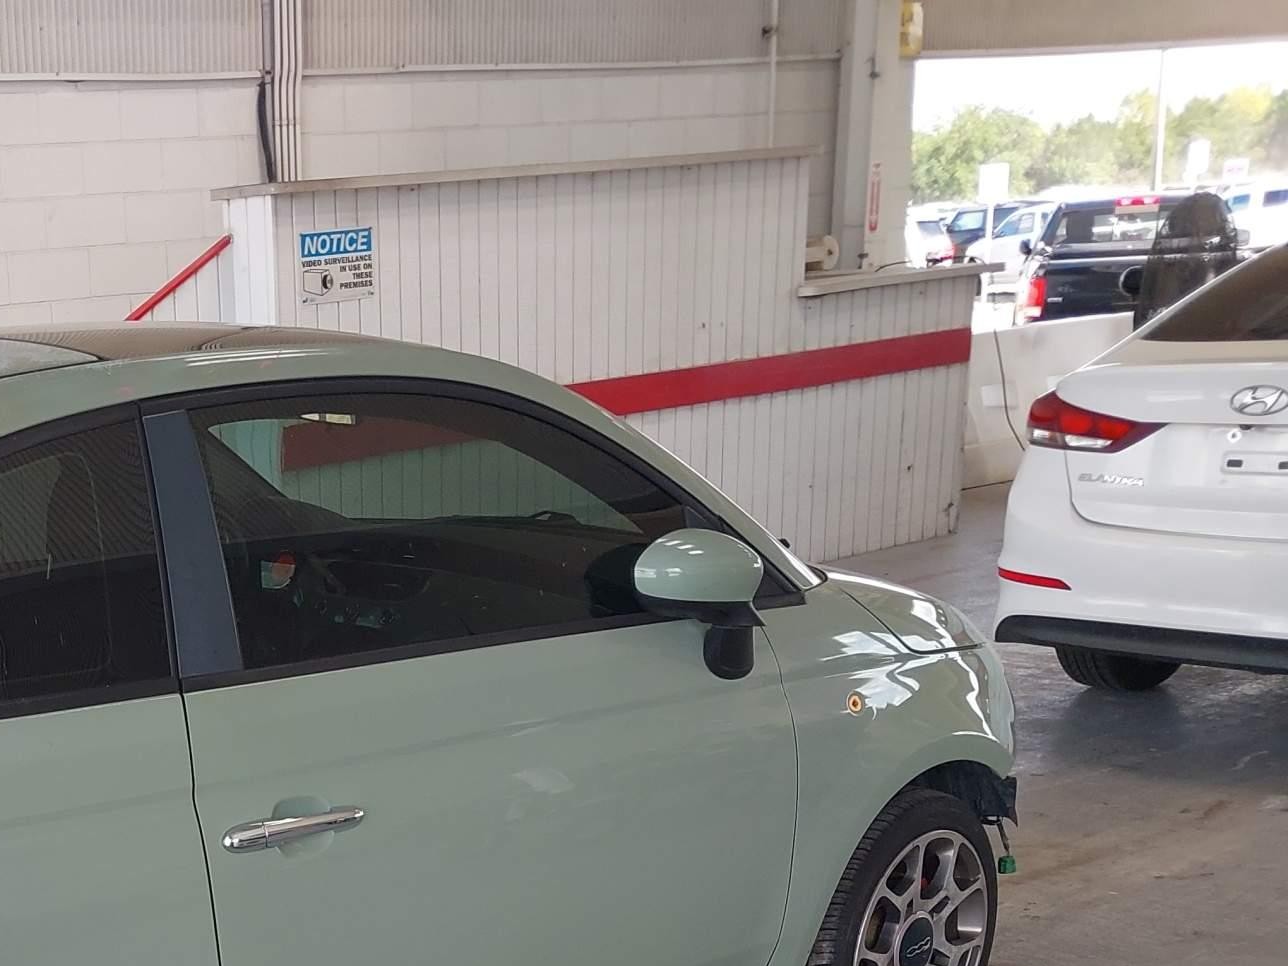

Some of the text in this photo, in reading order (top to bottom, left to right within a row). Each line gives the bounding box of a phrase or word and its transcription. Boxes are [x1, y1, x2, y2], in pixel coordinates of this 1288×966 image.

[304, 231, 369, 255] NOTICE
[302, 254, 372, 268] VIDEO SURVEILLANCE
[340, 262, 373, 273] IN USE ON
[352, 271, 373, 280] THESE
[339, 280, 373, 290] PREMISES
